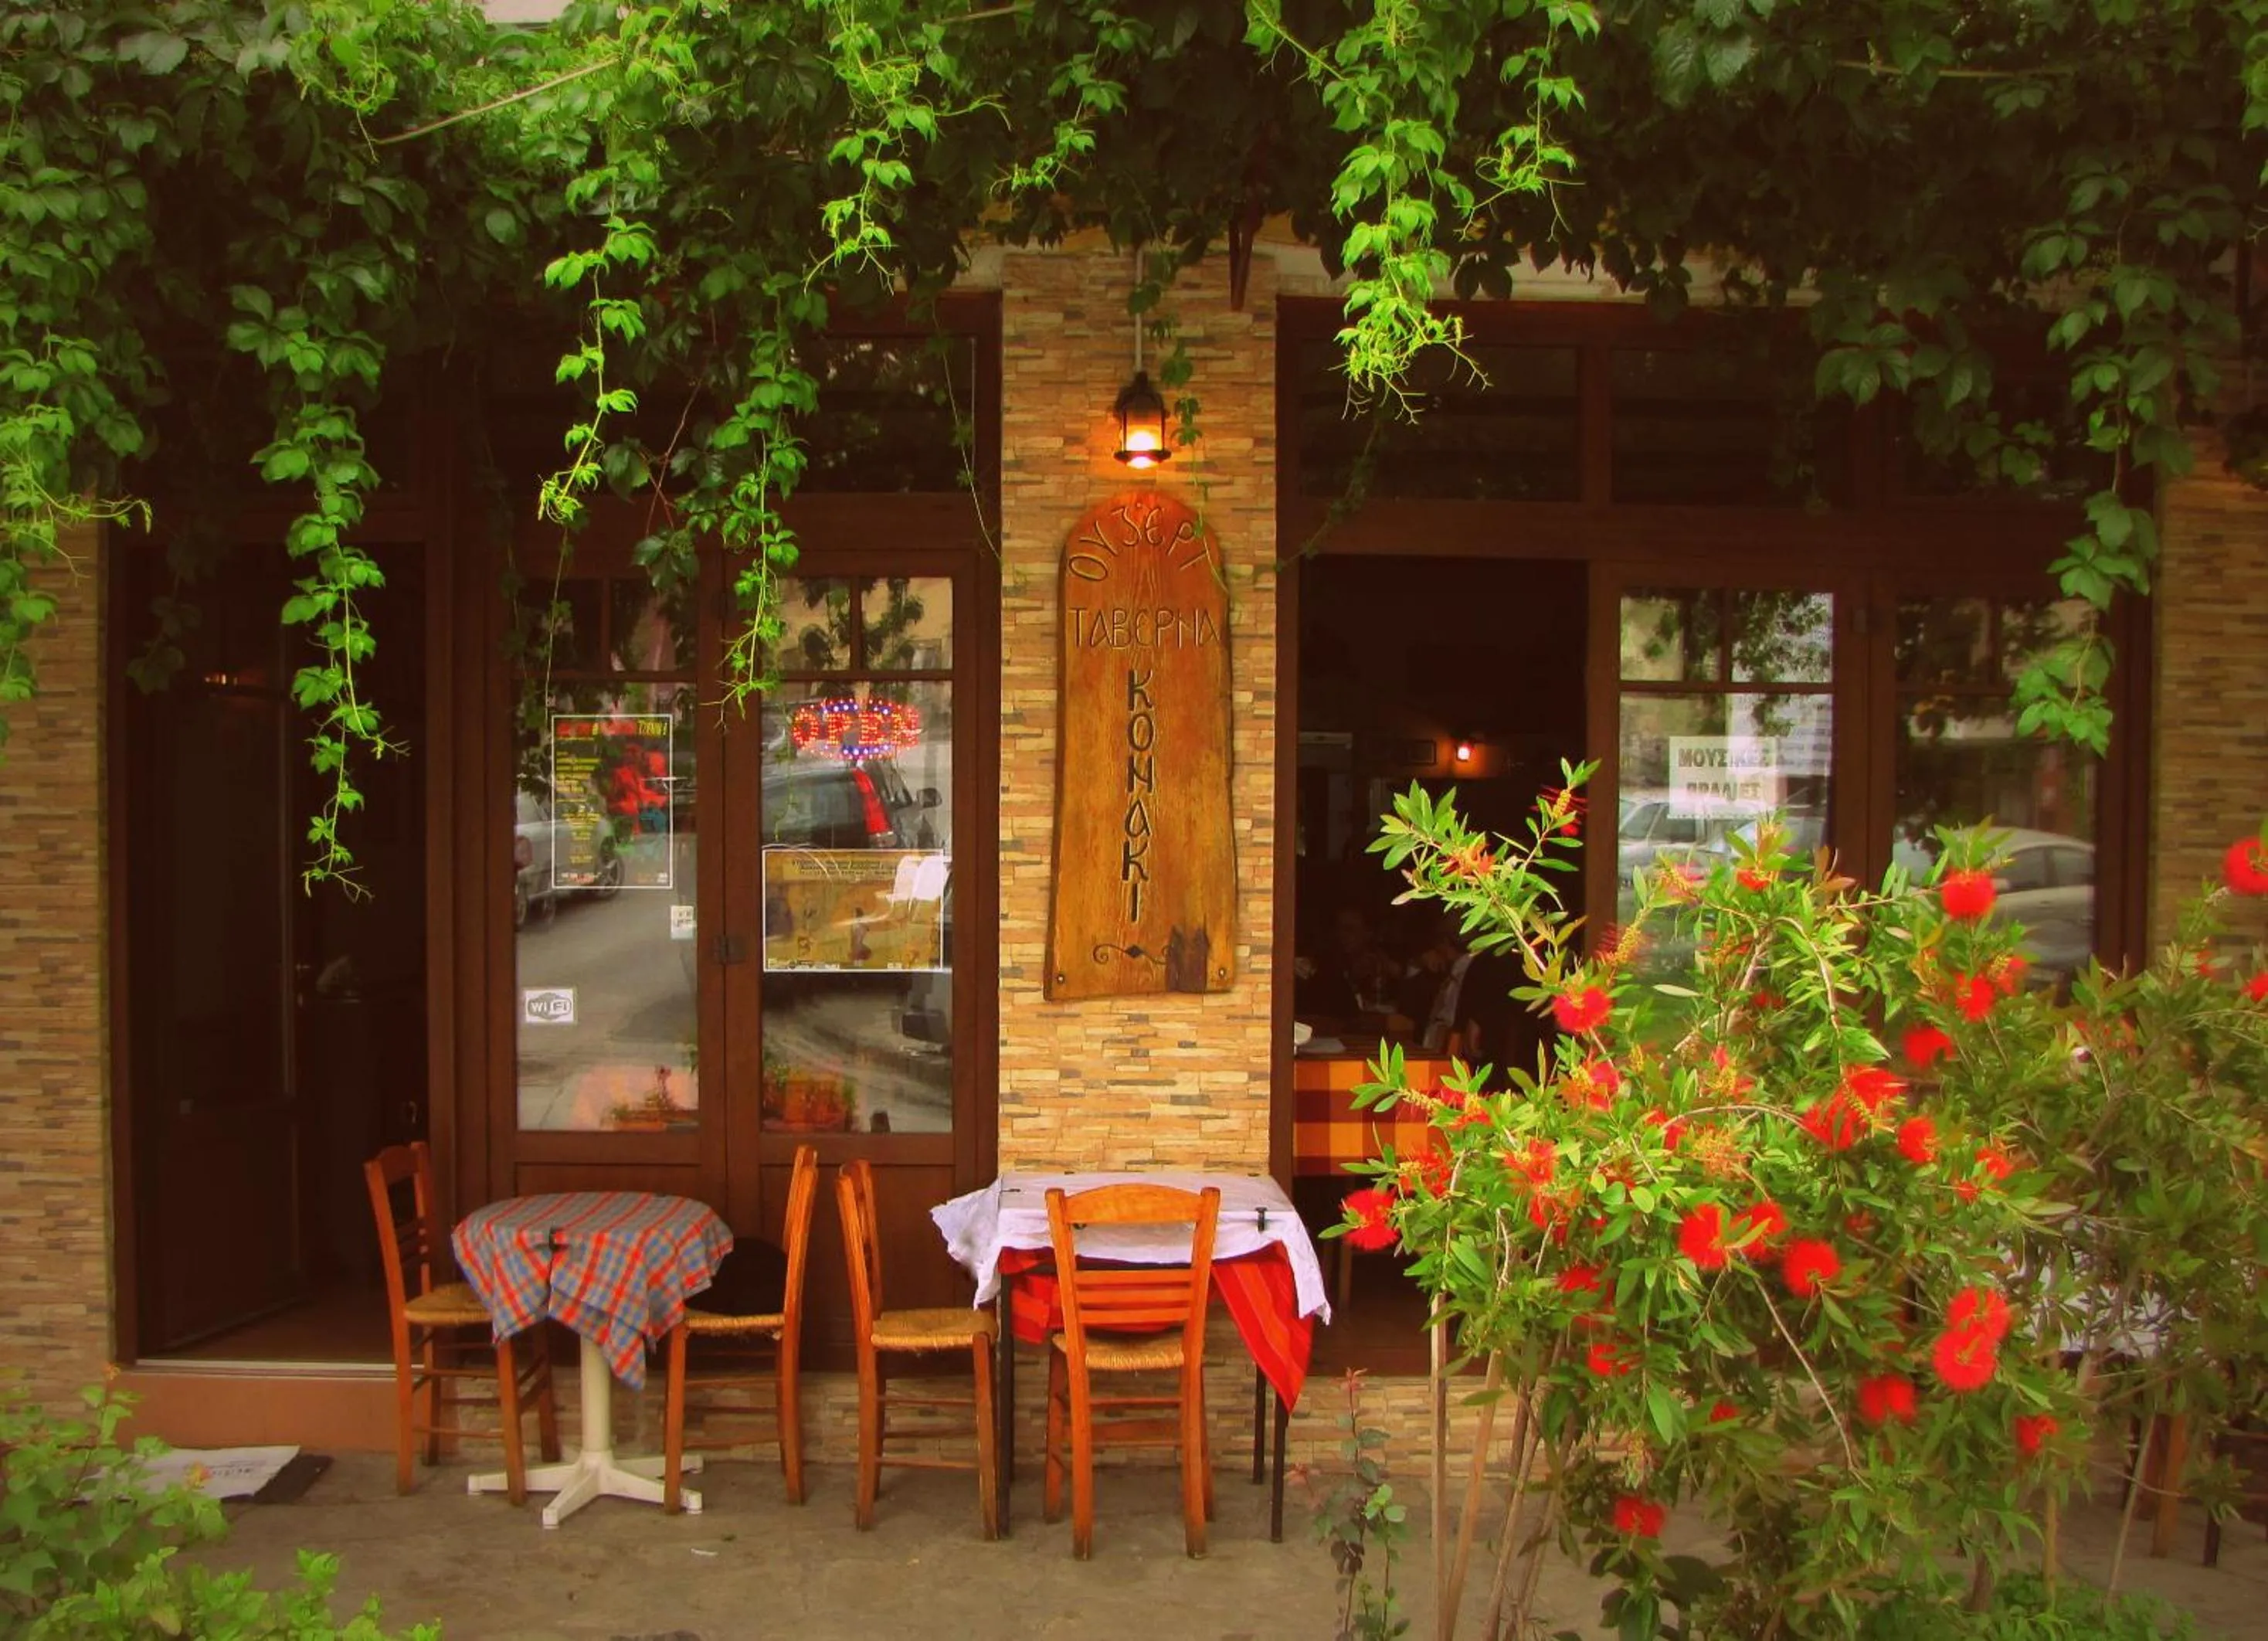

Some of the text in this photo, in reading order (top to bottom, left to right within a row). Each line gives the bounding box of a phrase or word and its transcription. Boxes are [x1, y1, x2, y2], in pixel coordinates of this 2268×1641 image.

[1068, 607, 1221, 649] ΤΑΒΕΡΝΑ
[792, 706, 920, 749] OPEN
[1122, 668, 1156, 922] ΚΟΝΑΚΙ
